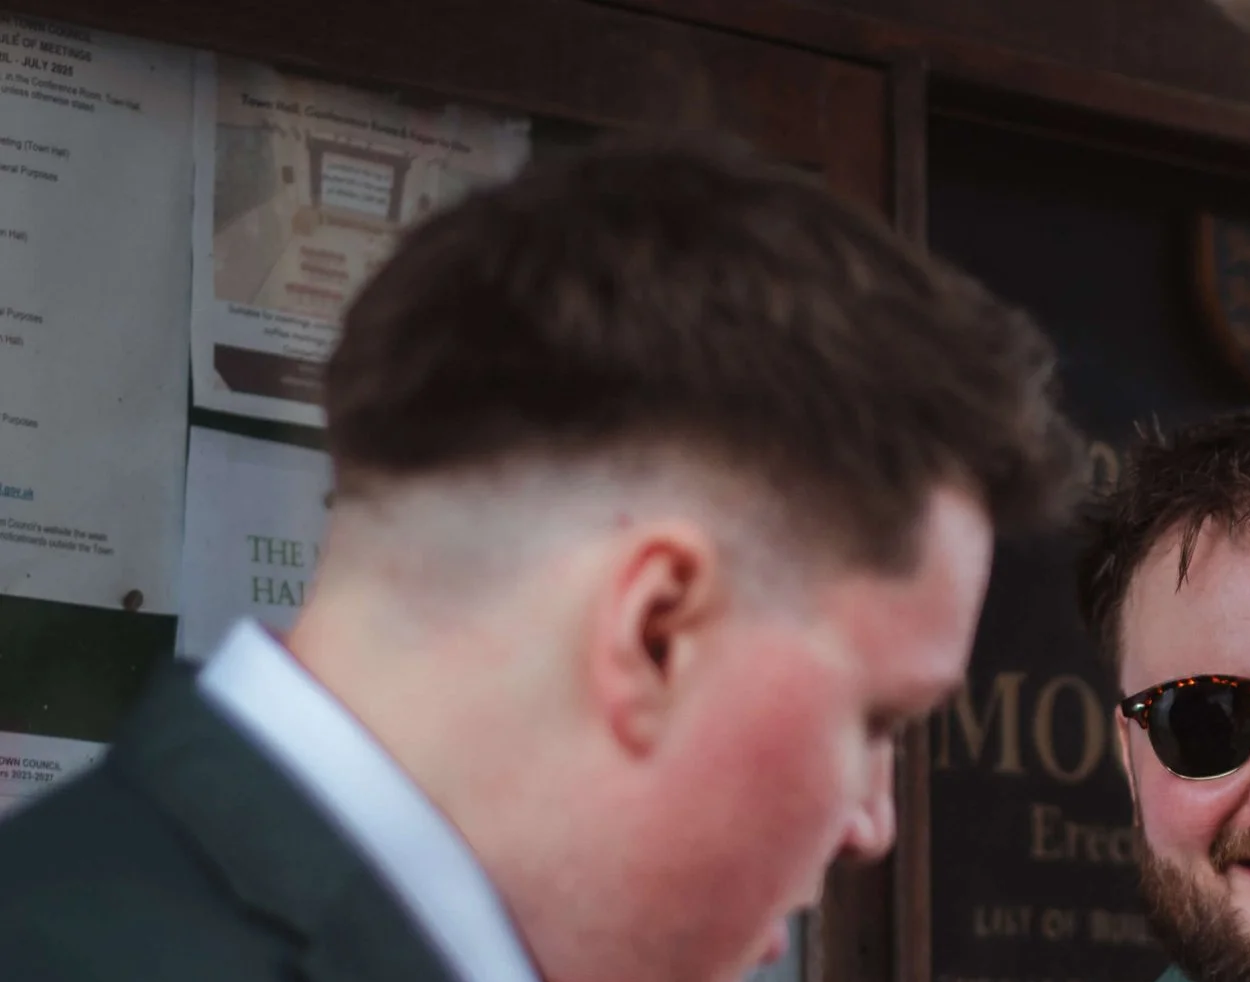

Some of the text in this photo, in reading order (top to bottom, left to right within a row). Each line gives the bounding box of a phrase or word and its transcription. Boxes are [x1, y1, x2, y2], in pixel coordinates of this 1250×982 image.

[22, 37, 37, 49] OF
[40, 41, 93, 62] MEETINGS
[21, 56, 48, 71] JULY
[246, 535, 305, 568] THE
[937, 670, 1122, 784] MO
[23, 758, 62, 771] COUNCIL
